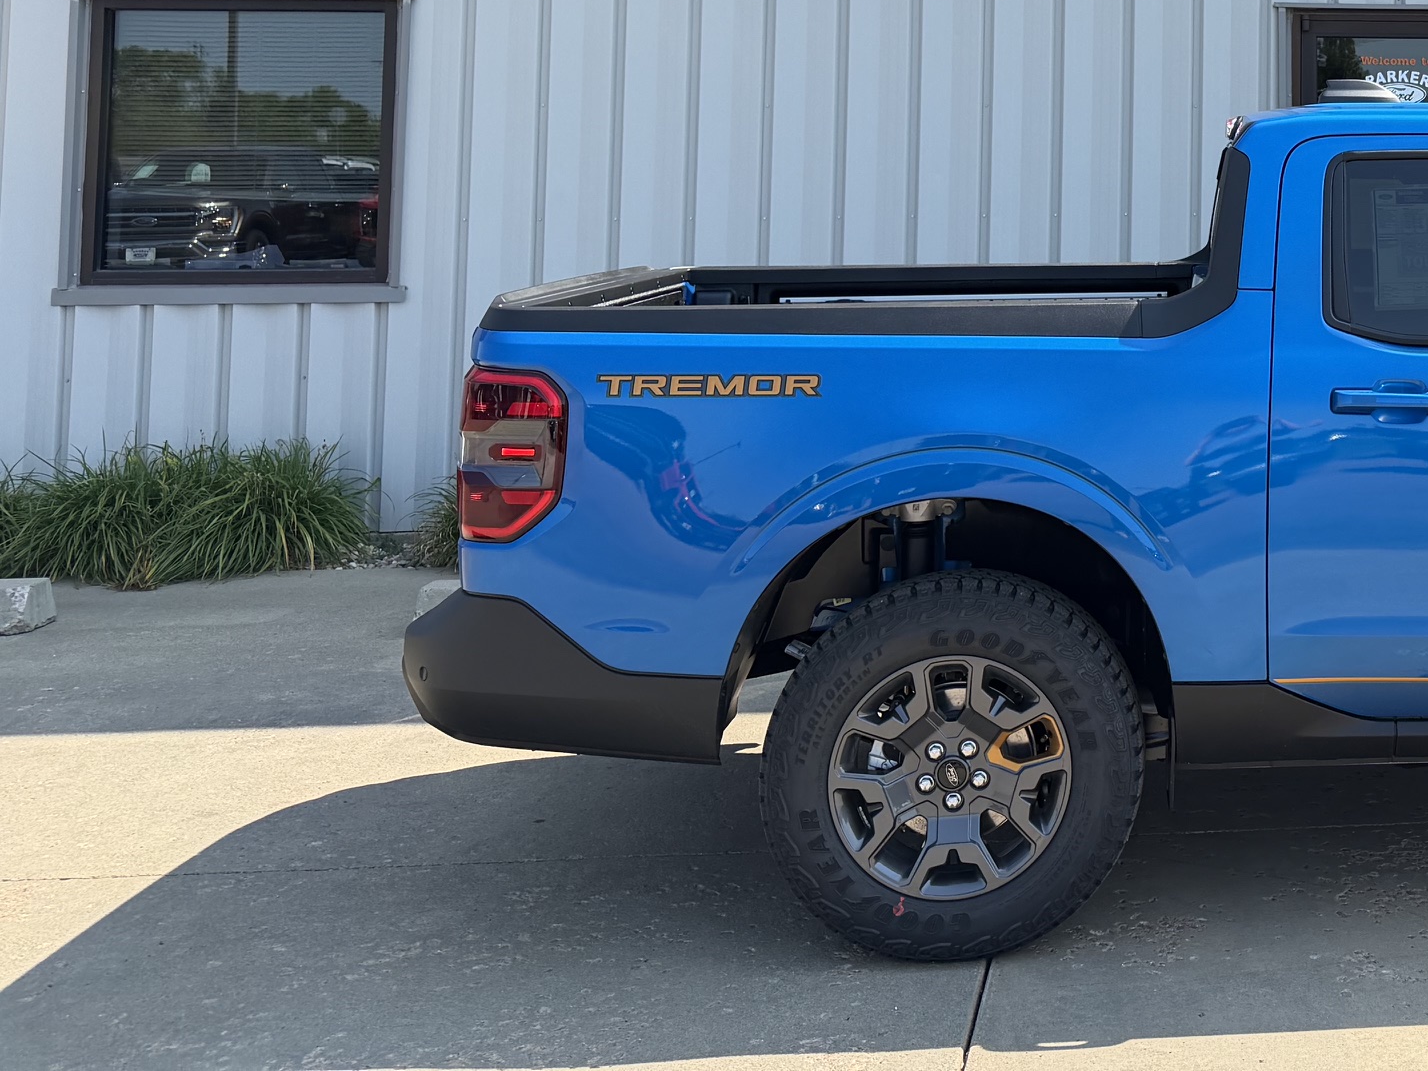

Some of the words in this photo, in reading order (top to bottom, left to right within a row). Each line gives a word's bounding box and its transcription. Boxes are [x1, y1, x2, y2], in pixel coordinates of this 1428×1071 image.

[1360, 56, 1416, 66] Welcome
[598, 374, 822, 398] TREMOR
[795, 669, 853, 765] TERRITORY
[812, 667, 872, 750] ALL-TERRAIN
[928, 629, 1099, 750] GOODYEAR
